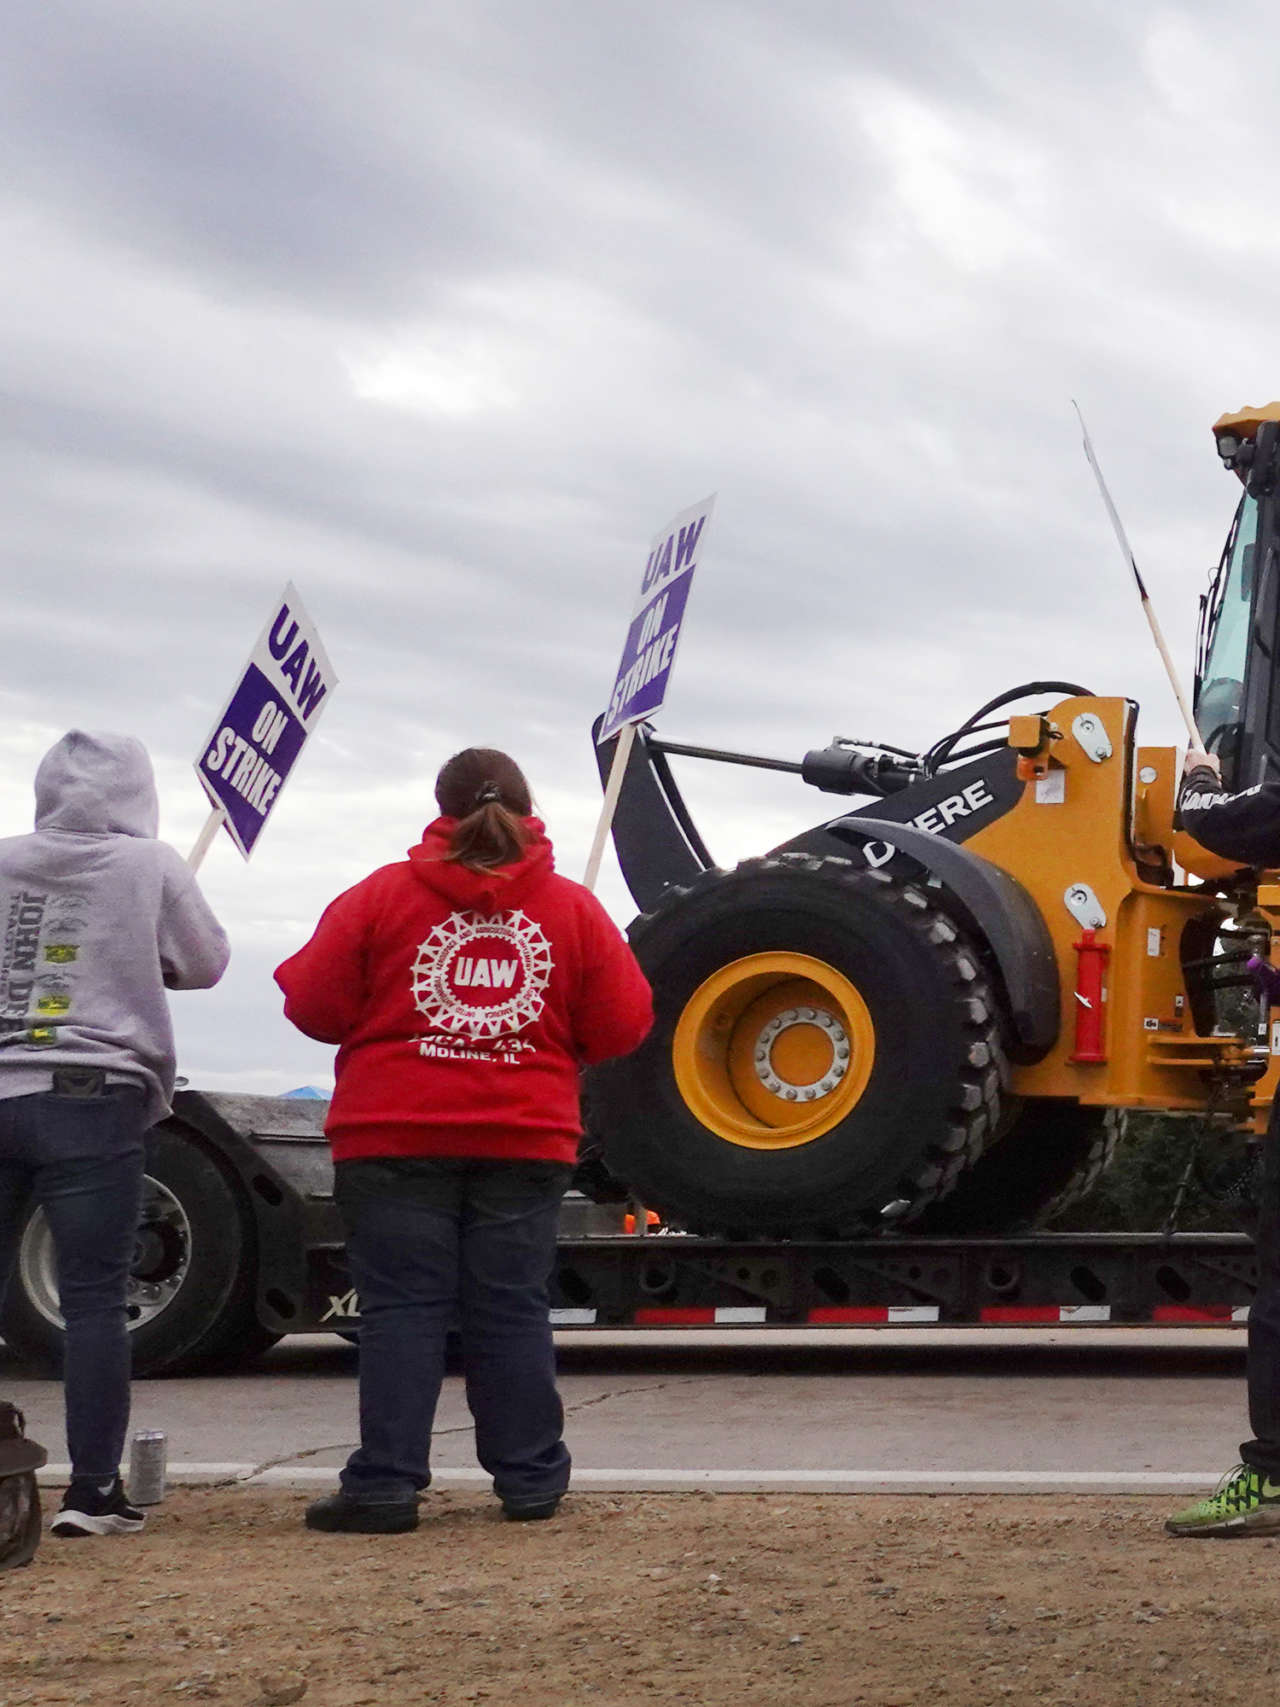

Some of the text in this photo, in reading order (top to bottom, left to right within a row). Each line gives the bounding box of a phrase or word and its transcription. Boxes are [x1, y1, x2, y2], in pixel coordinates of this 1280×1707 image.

[640, 515, 706, 596] UAW
[268, 603, 327, 722] UAW
[636, 591, 670, 655] ON
[607, 622, 679, 726] STRIKE
[252, 700, 289, 756] ON
[206, 726, 282, 817] STRIKE
[862, 779, 994, 868] DERE
[11, 891, 48, 971] JOHN
[453, 956, 519, 988] UAW
[419, 1042, 521, 1065] MOLINE, IL
